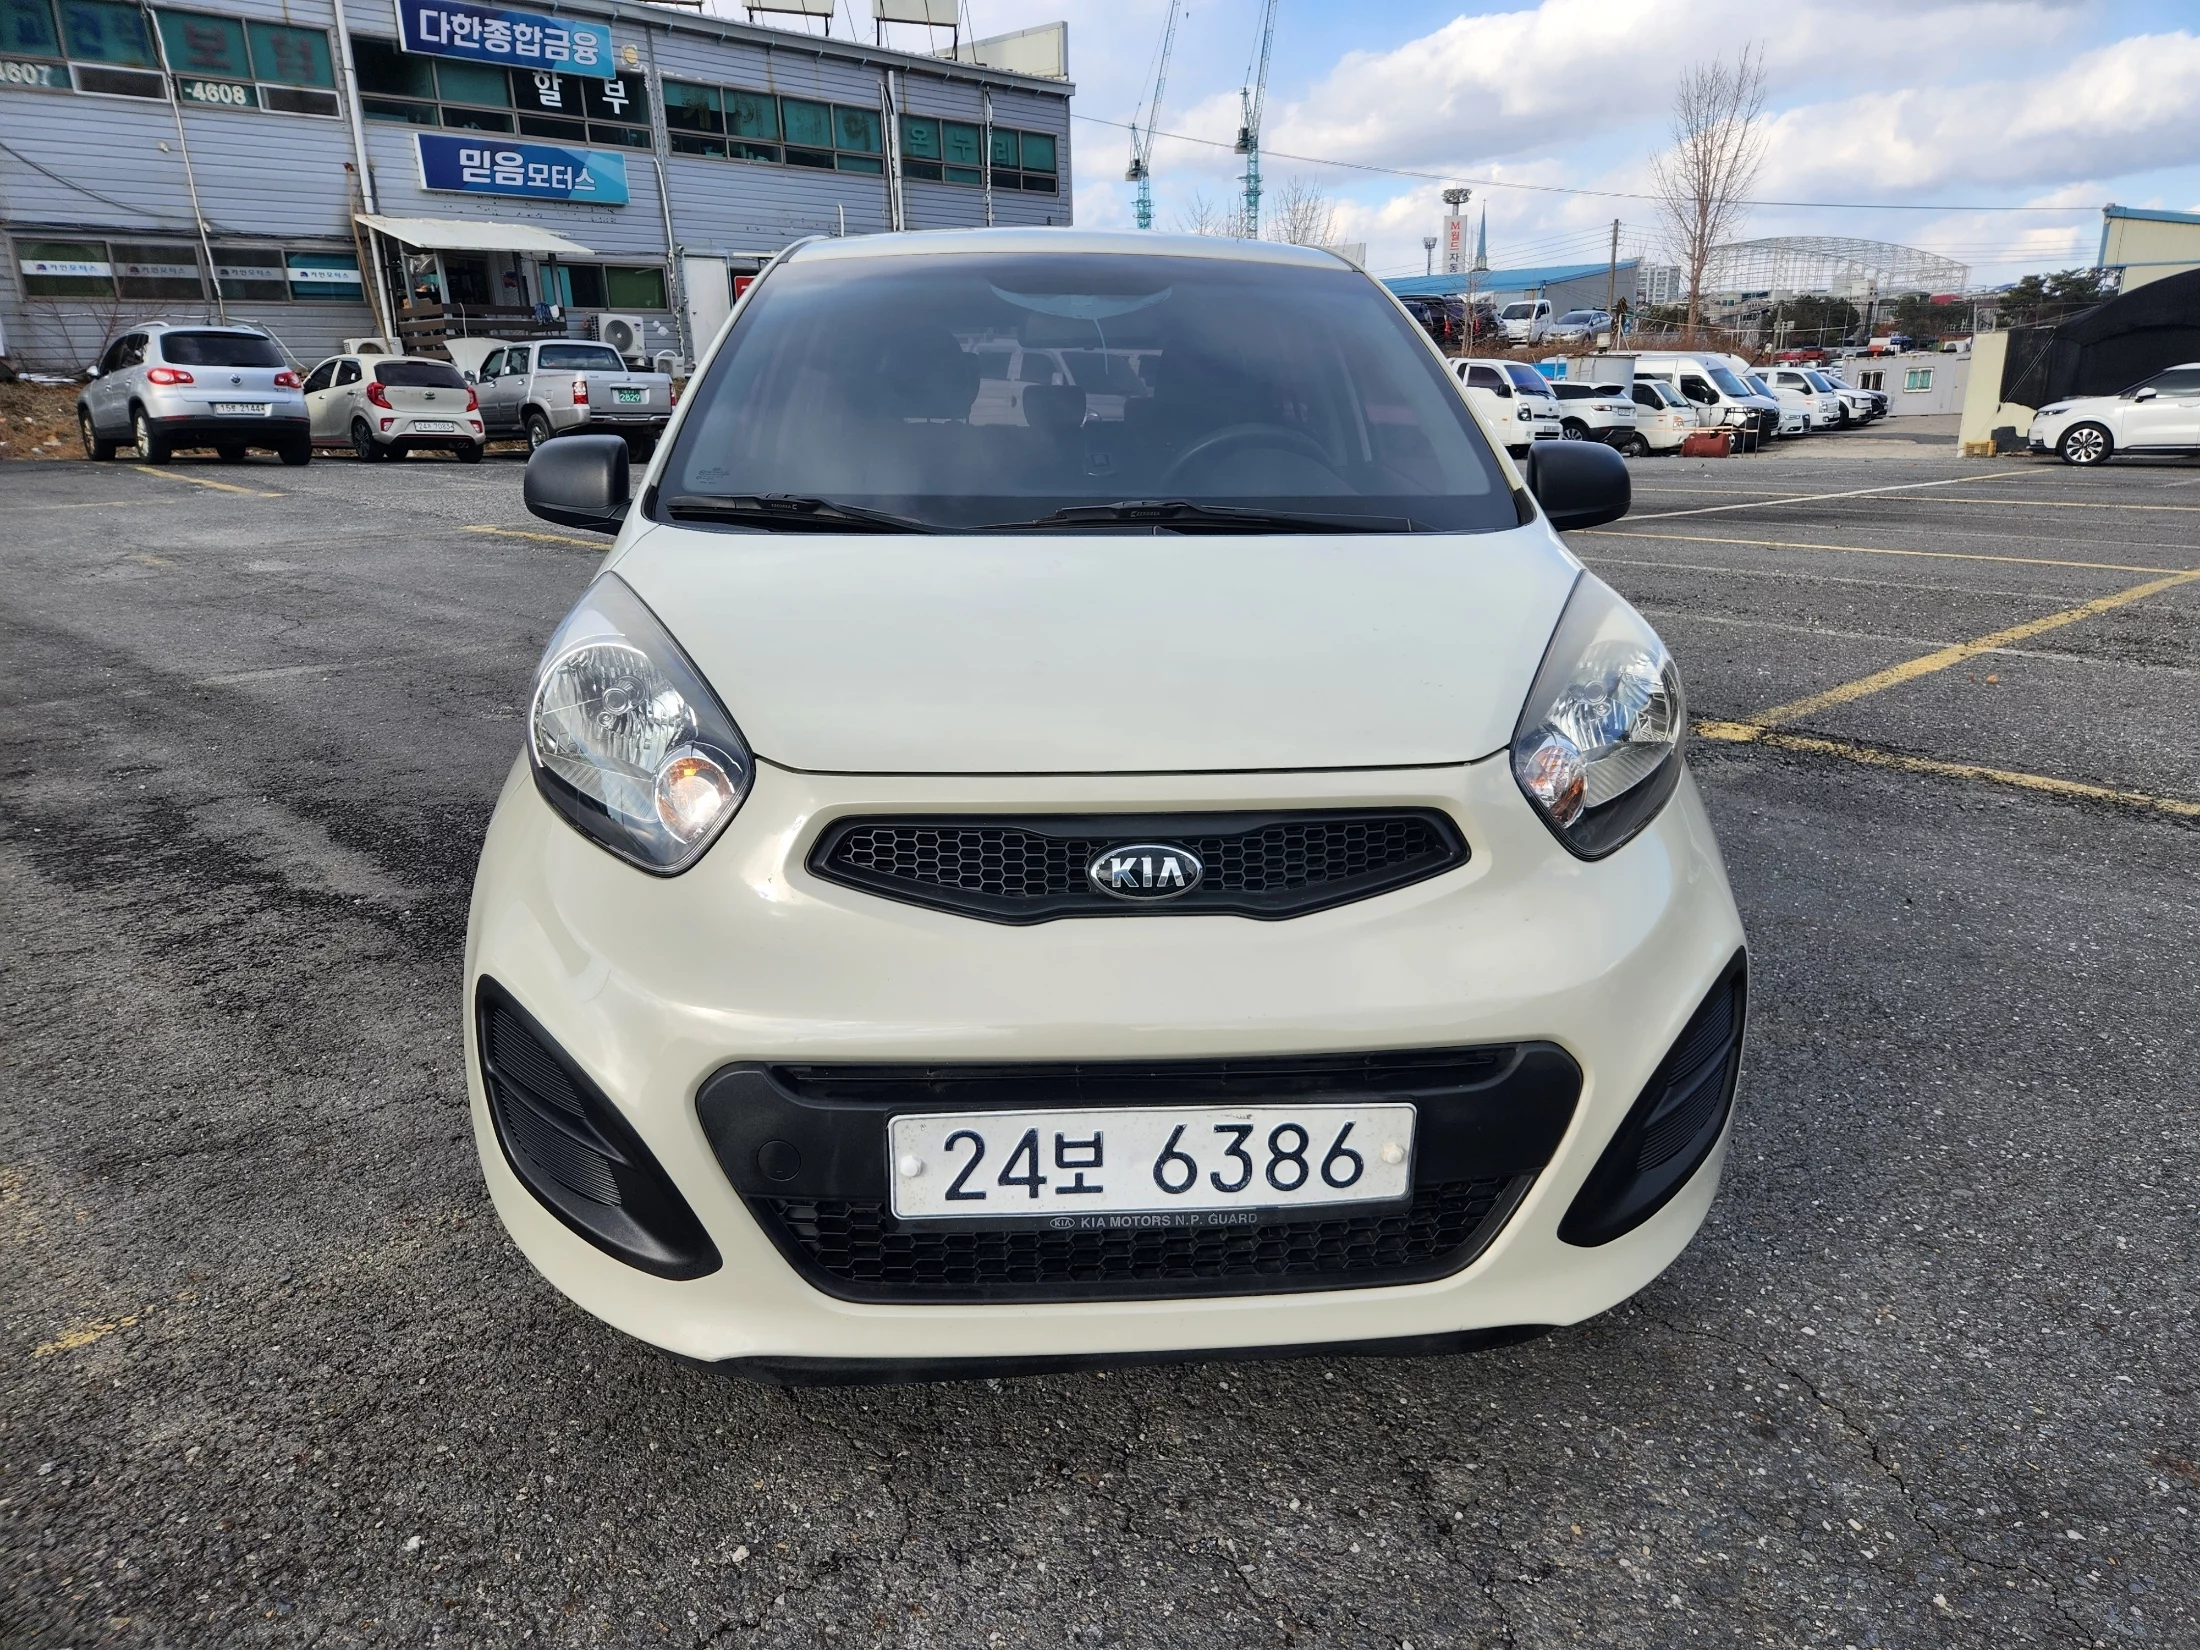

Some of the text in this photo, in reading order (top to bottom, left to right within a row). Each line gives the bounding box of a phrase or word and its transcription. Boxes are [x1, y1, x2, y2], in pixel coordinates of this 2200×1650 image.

[419, 9, 600, 66] 다한종합금융
[459, 148, 596, 192] 믿음모터스
[1449, 221, 1460, 250] M월드
[619, 393, 640, 401] 2829
[1110, 857, 1186, 888] KIA
[943, 1122, 1365, 1200] 24보 6386
[1081, 1217, 1106, 1228] KIA
[1109, 1214, 1171, 1228] MOTORS
[1175, 1214, 1203, 1226] N.P.
[1208, 1212, 1258, 1225] GUARD
